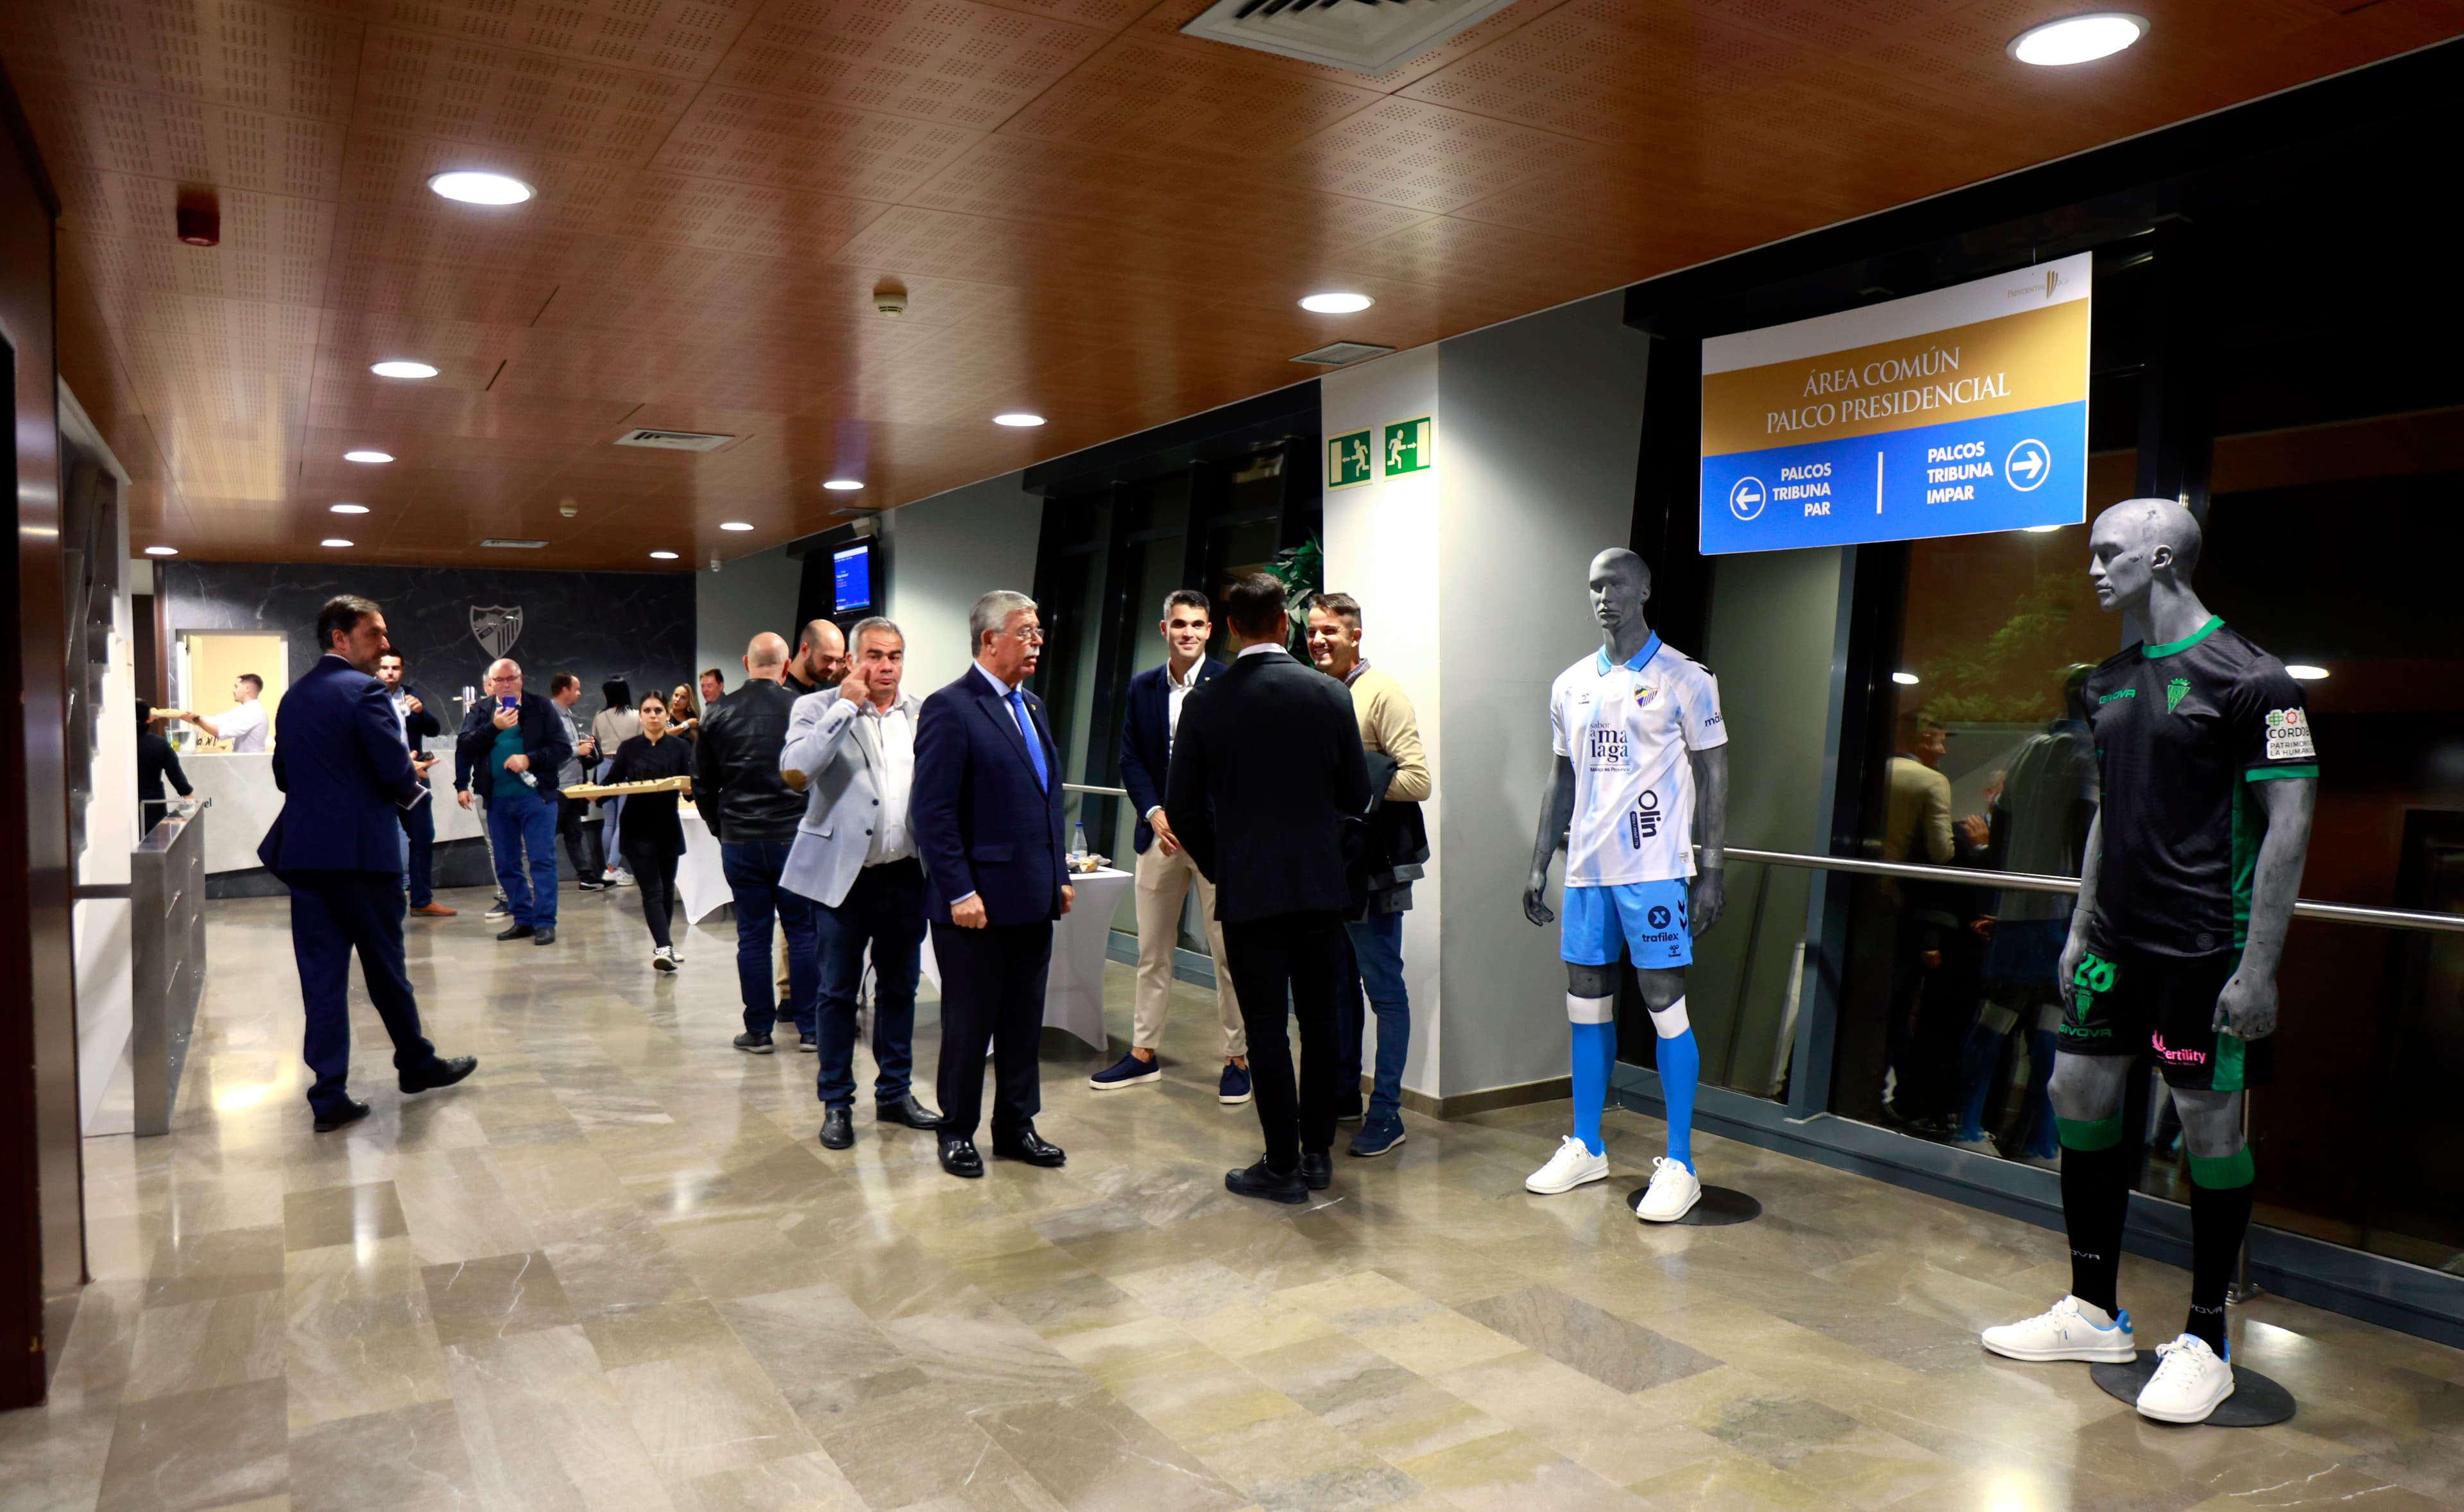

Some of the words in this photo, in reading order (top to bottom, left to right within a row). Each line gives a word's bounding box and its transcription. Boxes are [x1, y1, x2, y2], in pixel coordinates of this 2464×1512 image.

[1802, 369, 1860, 397] ÁREA
[1863, 345, 1960, 386] COMÚN
[1765, 403, 1835, 434] PALCO
[1840, 372, 2011, 423] PRESIDENCIAL
[1928, 442, 1985, 463] PALCOS
[1781, 463, 1832, 481] PALCOS
[1926, 461, 1994, 484] TRIBUNA
[1772, 482, 1831, 501] TRIBUNA
[1926, 485, 1974, 504] IMPAR
[1804, 501, 1831, 517] PAR
[1590, 721, 1611, 729] sabor
[1642, 932, 1679, 942] trafilex
[2058, 1023, 2112, 1037] GIVOVA
